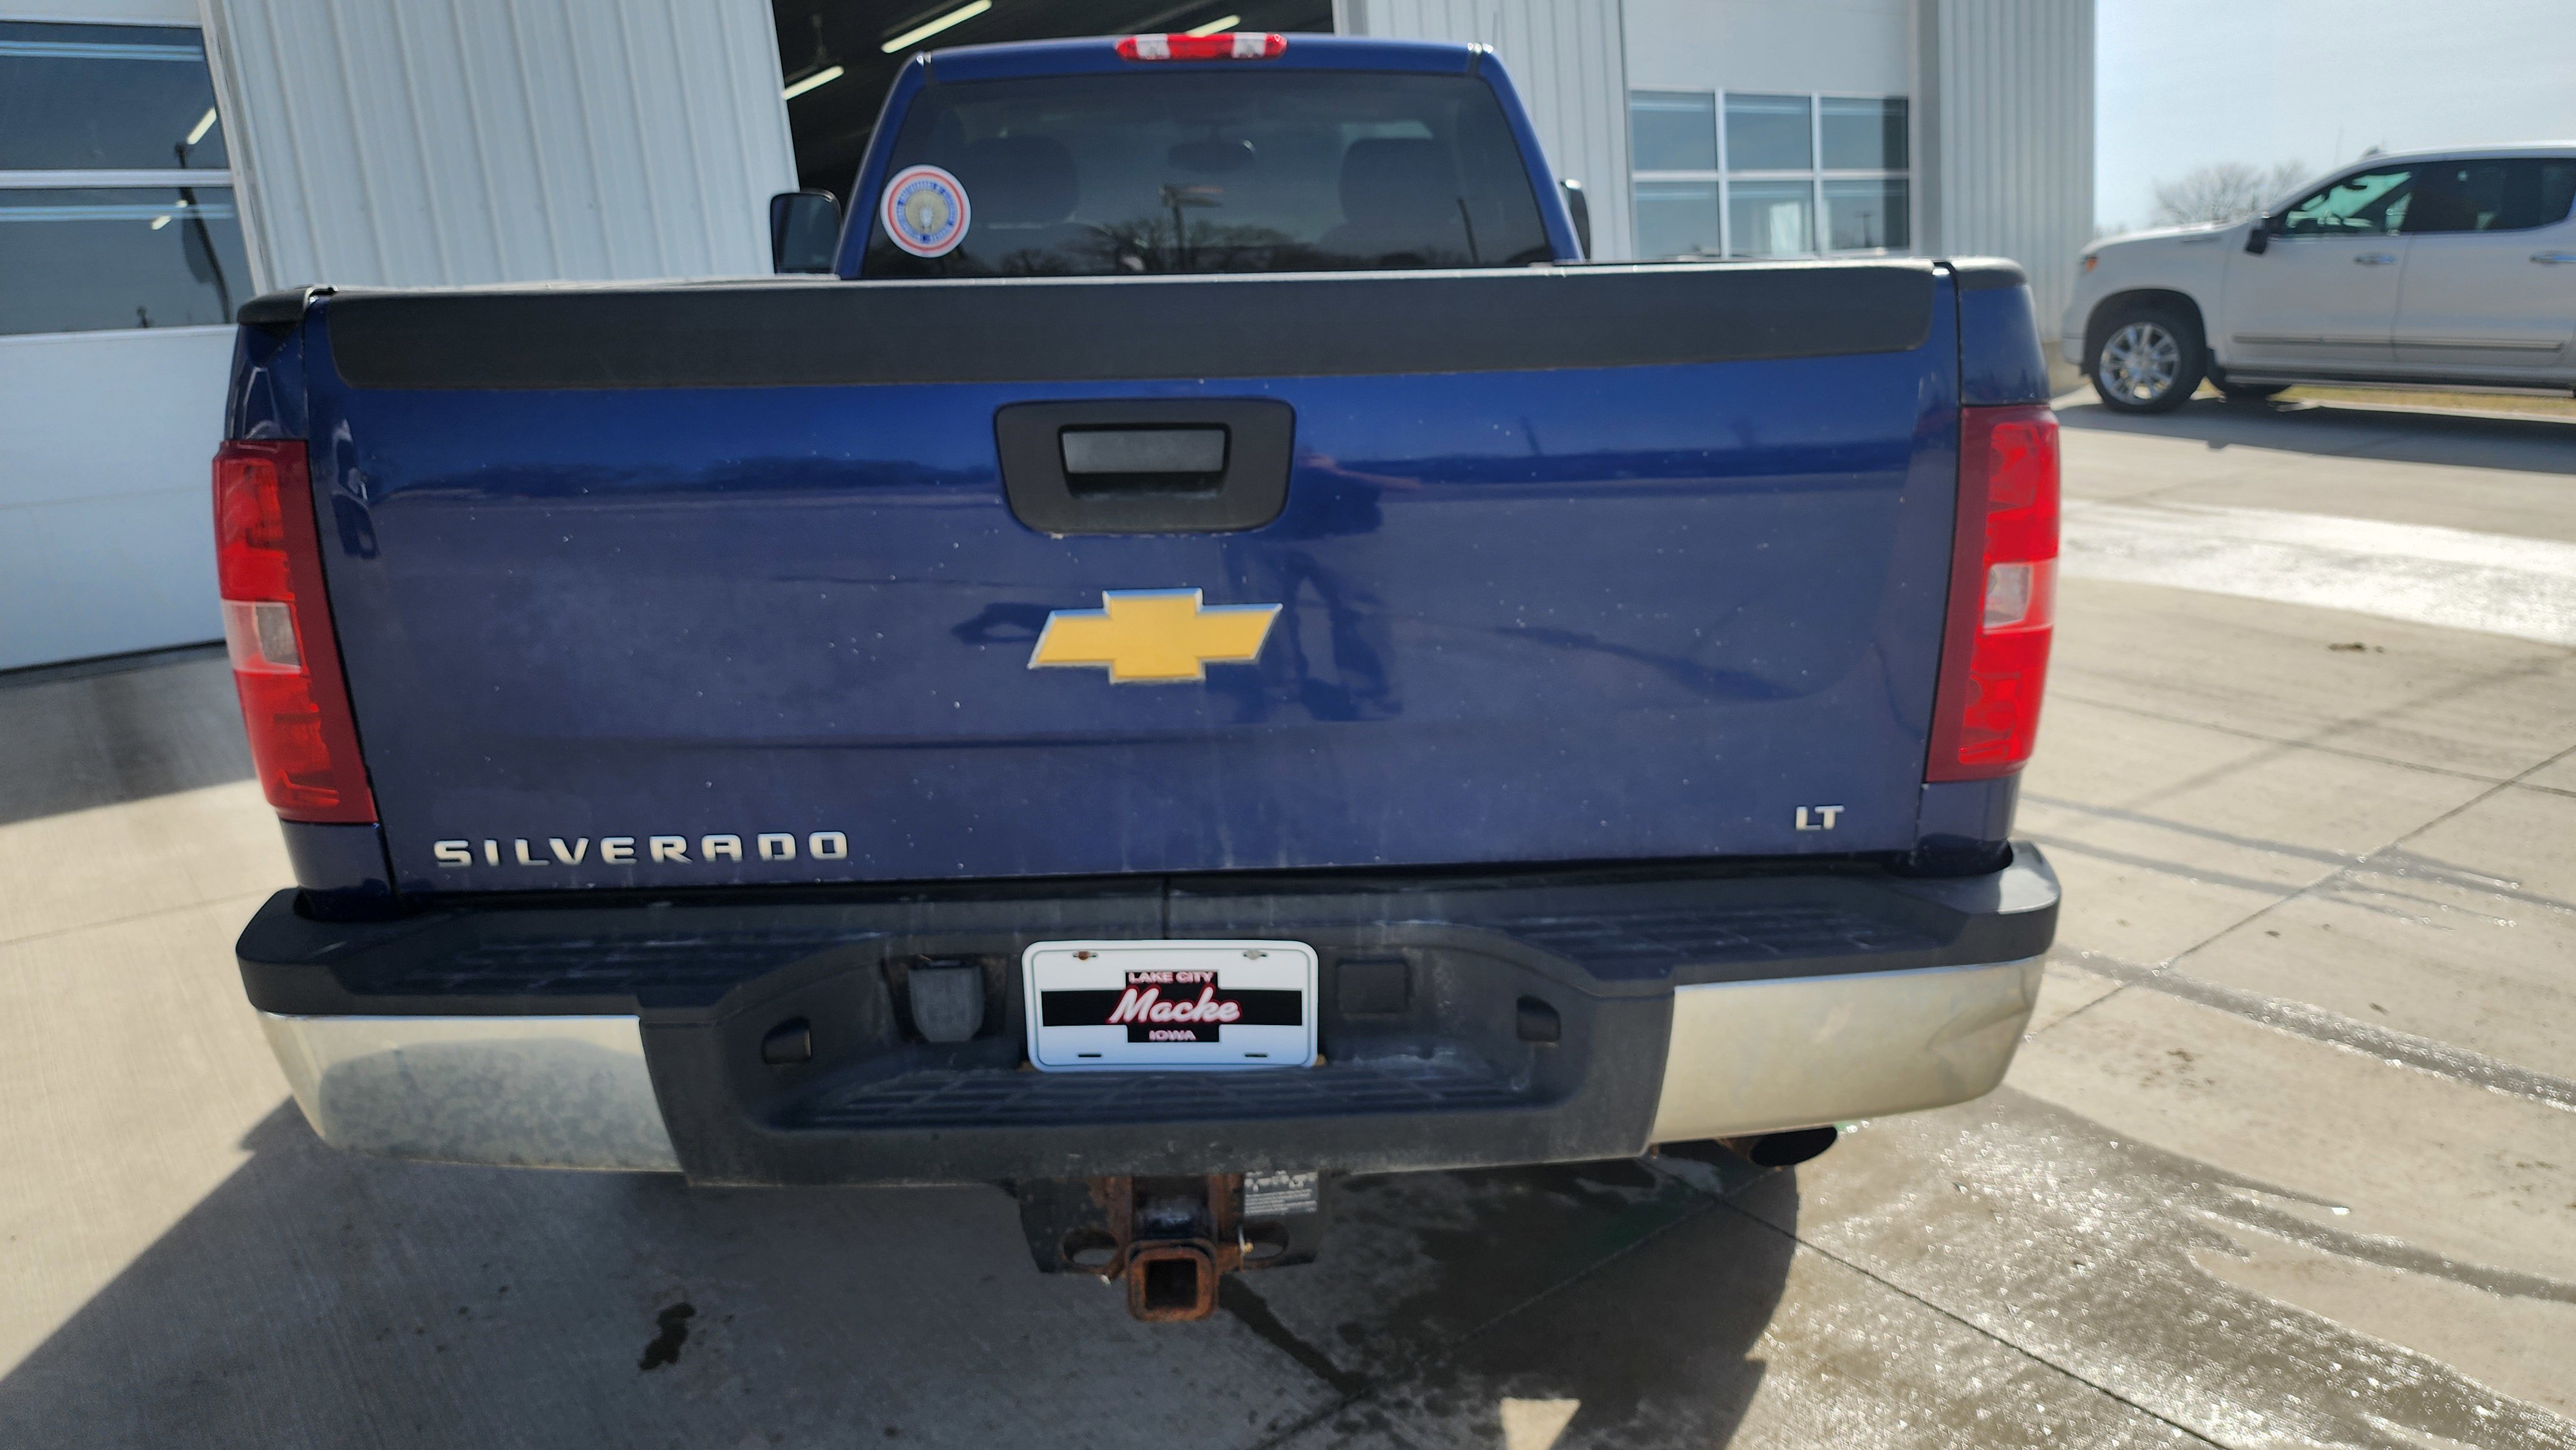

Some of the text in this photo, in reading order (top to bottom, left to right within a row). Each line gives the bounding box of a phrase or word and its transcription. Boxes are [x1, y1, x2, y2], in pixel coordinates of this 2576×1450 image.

[1795, 805, 1845, 831] LT
[433, 831, 848, 867] SILVERADO
[1128, 971, 1214, 984] LAKE CITY
[1106, 986, 1242, 1024] Macke
[1149, 1030, 1197, 1041] IOWA
